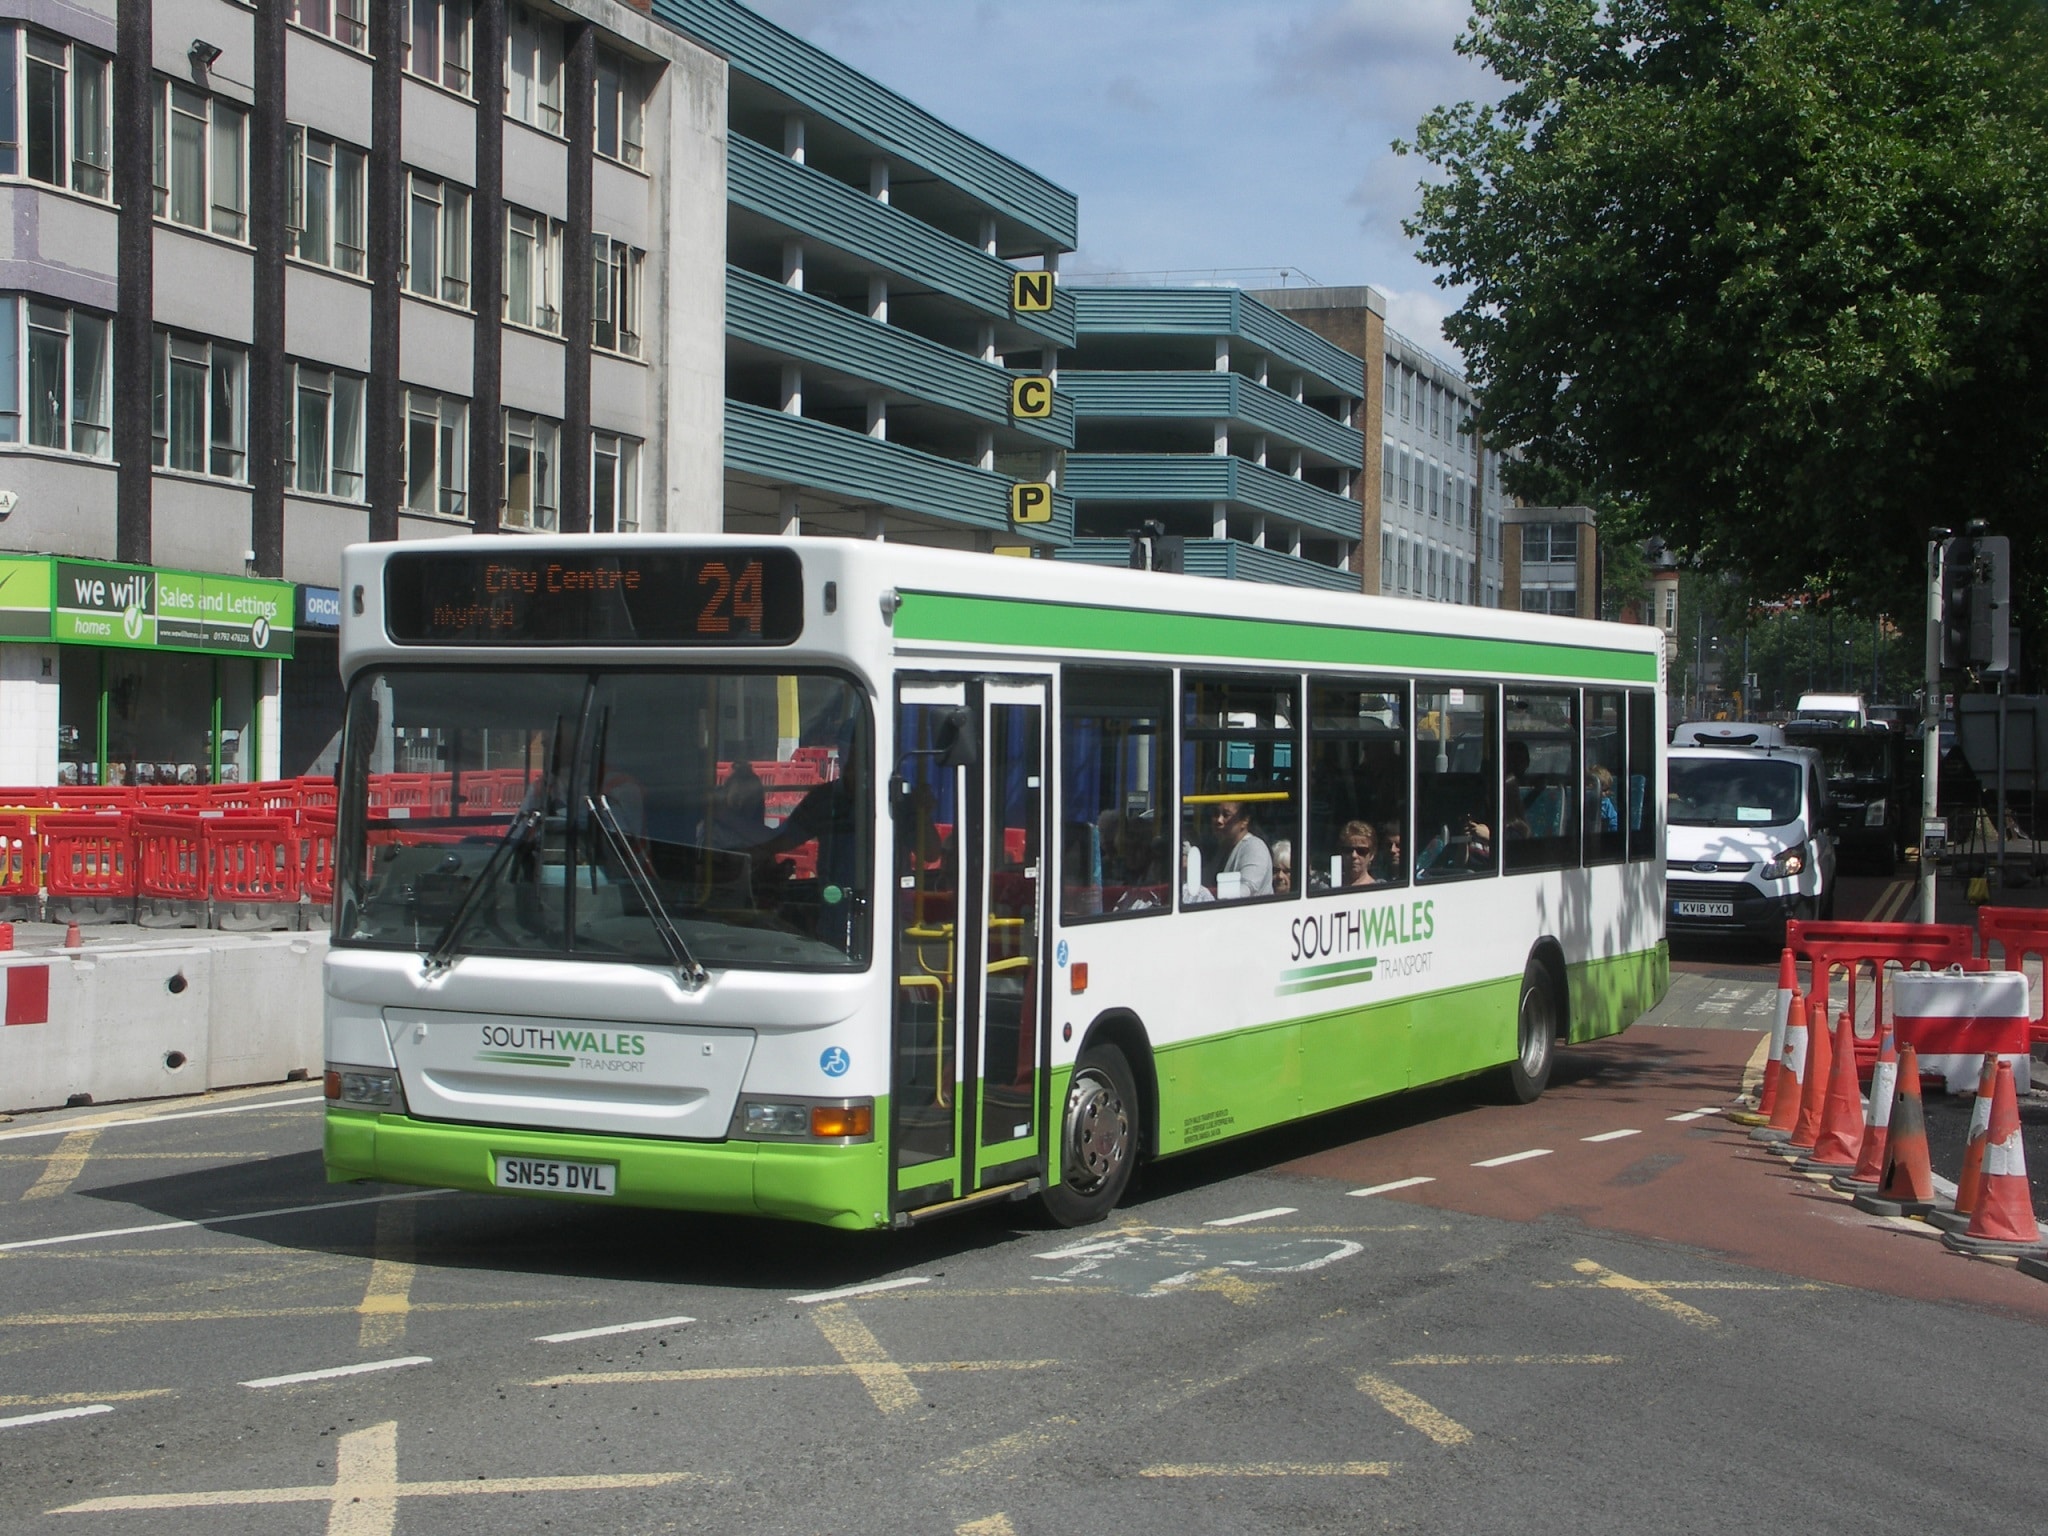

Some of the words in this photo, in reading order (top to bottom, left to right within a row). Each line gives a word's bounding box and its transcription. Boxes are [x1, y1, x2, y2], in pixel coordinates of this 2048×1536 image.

[1018, 275, 1048, 307] N
[1018, 381, 1045, 413] C
[1019, 487, 1044, 518] P
[74, 578, 105, 606] we
[110, 575, 147, 610] will
[486, 565, 537, 592] City
[547, 564, 640, 592] Centre
[160, 586, 195, 608] Sales
[198, 592, 223, 611] and
[227, 593, 277, 620] Lettings
[308, 597, 341, 615] ORCH
[697, 562, 763, 632] 24
[75, 617, 111, 636] homes
[1379, 951, 1433, 980] TRANSPORT
[579, 1058, 645, 1073] TRANSPORT
[505, 1160, 560, 1186] SN55
[566, 1165, 606, 1191] DVL
